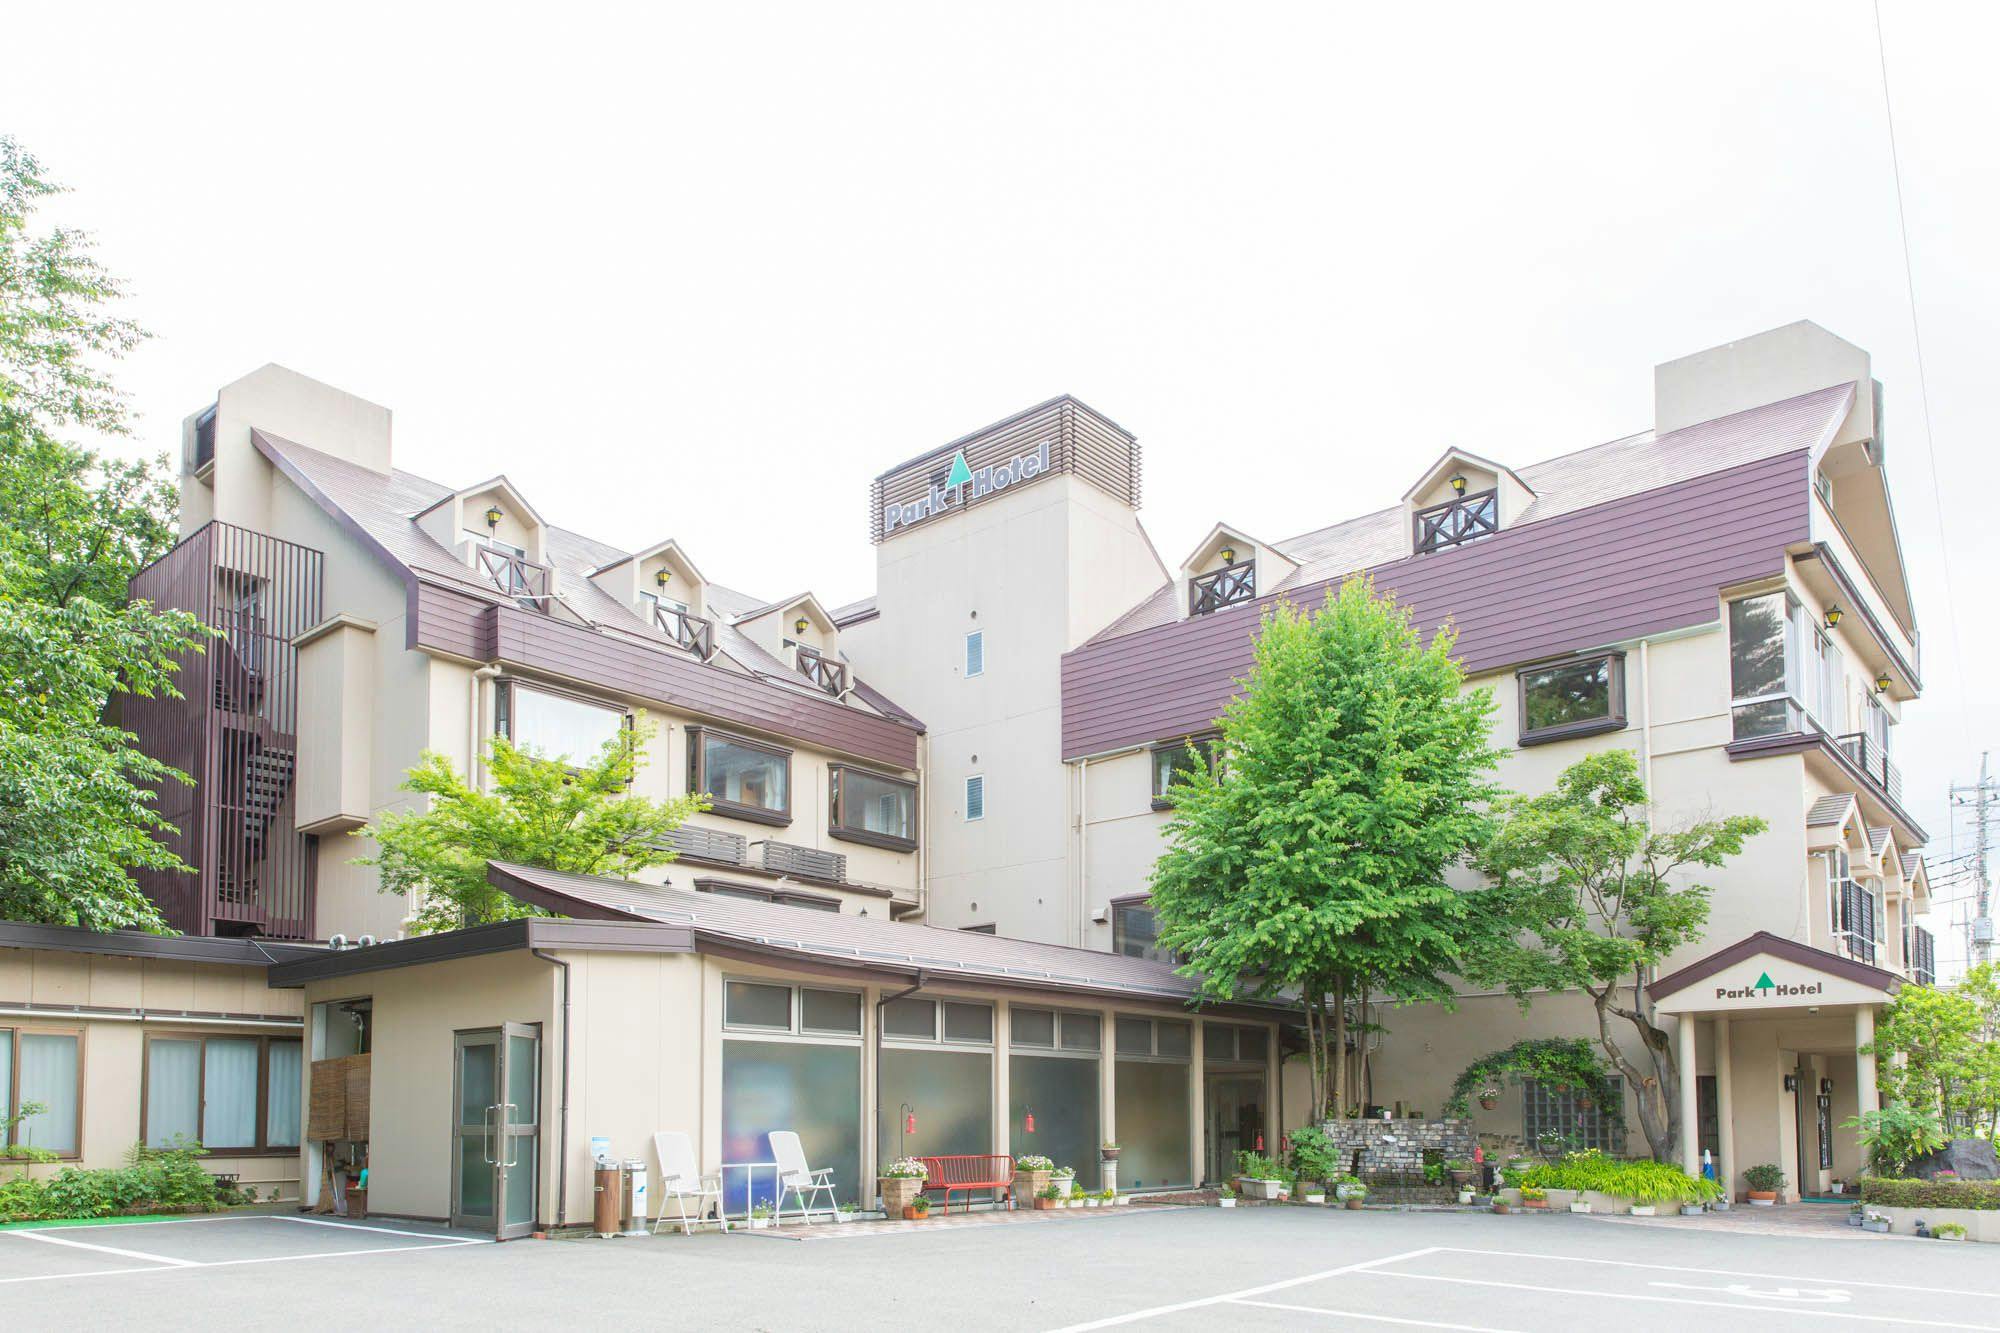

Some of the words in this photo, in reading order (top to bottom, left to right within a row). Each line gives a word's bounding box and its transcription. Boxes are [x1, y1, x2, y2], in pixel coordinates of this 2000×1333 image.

[885, 484, 949, 532] Park
[972, 441, 1050, 499] Hotel
[1716, 986, 1755, 999] Park
[1776, 982, 1823, 996] Hotel
